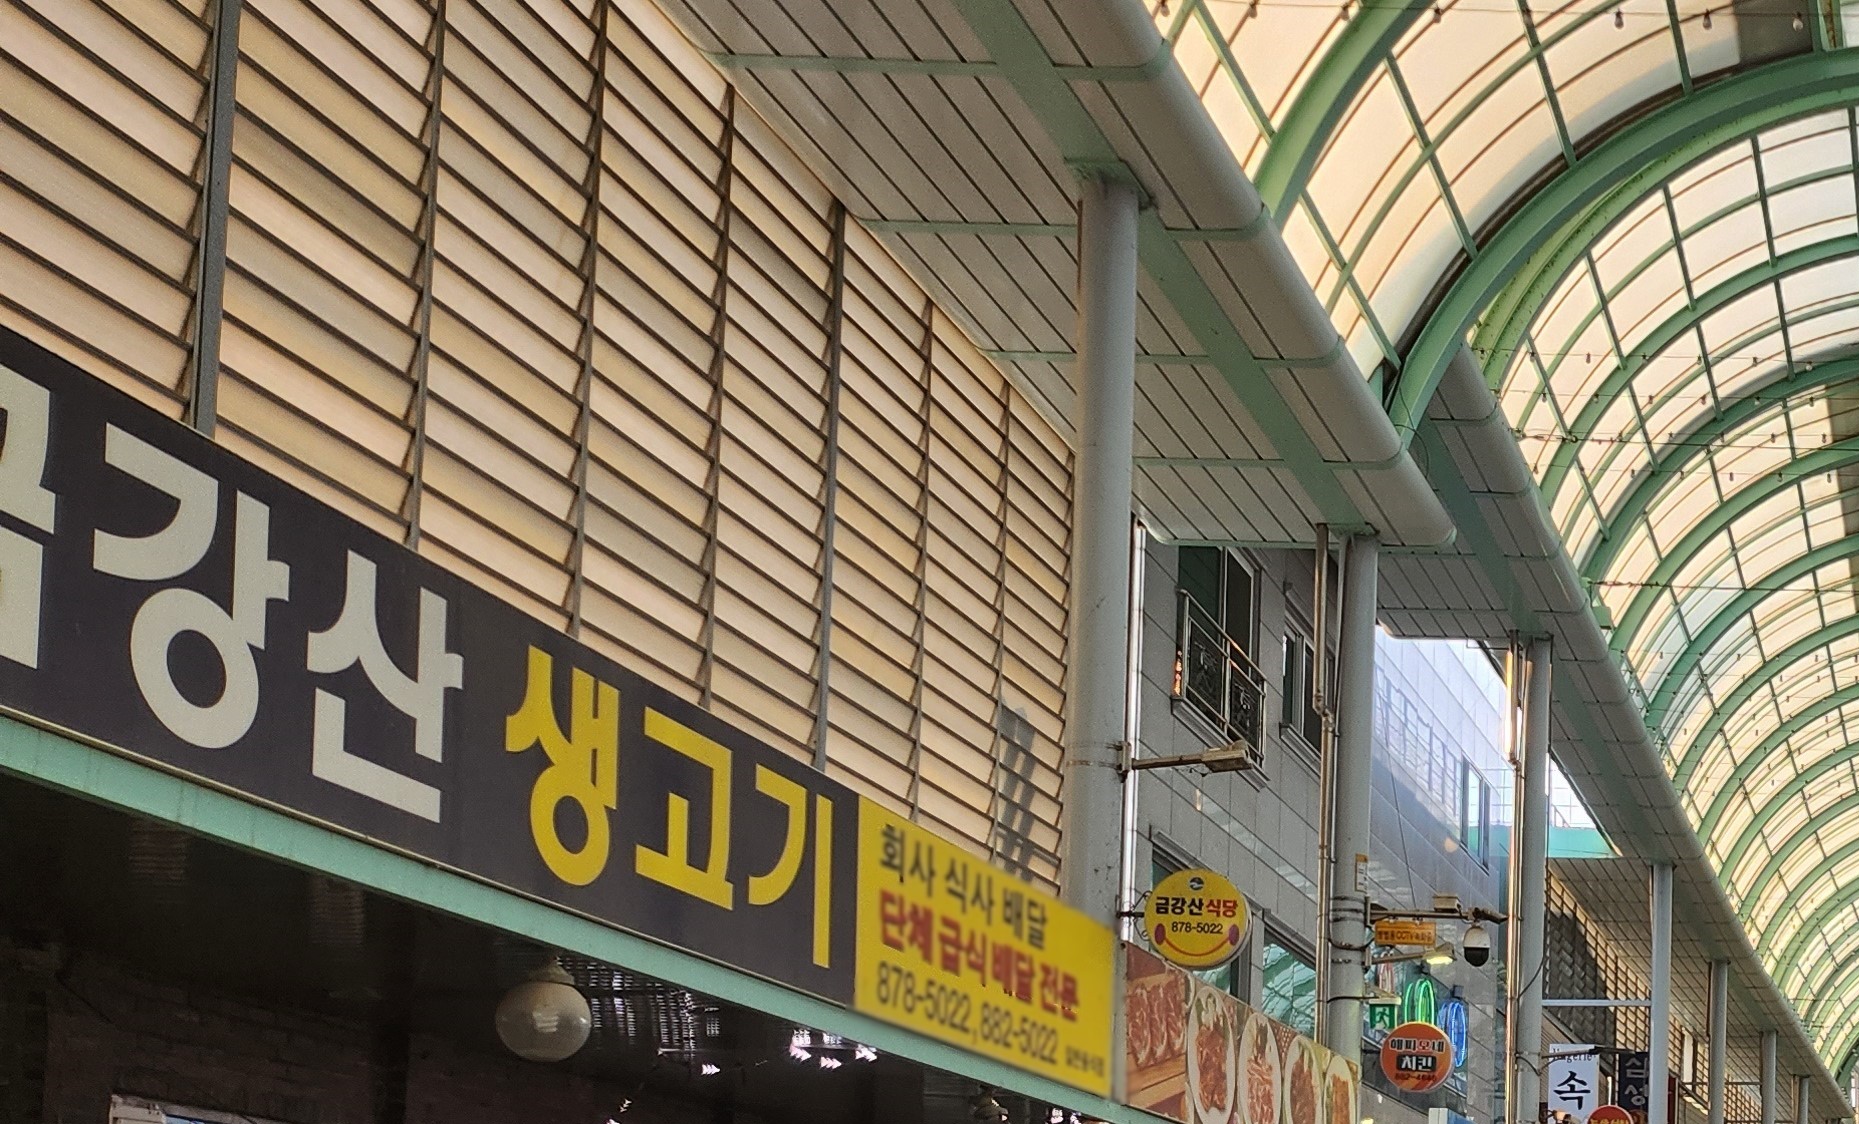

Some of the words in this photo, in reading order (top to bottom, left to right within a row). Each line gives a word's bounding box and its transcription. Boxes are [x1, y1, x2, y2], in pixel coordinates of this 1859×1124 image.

[506, 645, 833, 968] 생고기
[880, 823, 935, 898] 회사
[945, 857, 995, 927] 식사
[1002, 887, 1047, 950] 배달
[1171, 921, 1223, 934] 878-5022
[980, 1002, 1060, 1065] 882-5022
[1401, 1055, 1433, 1072] 치킨
